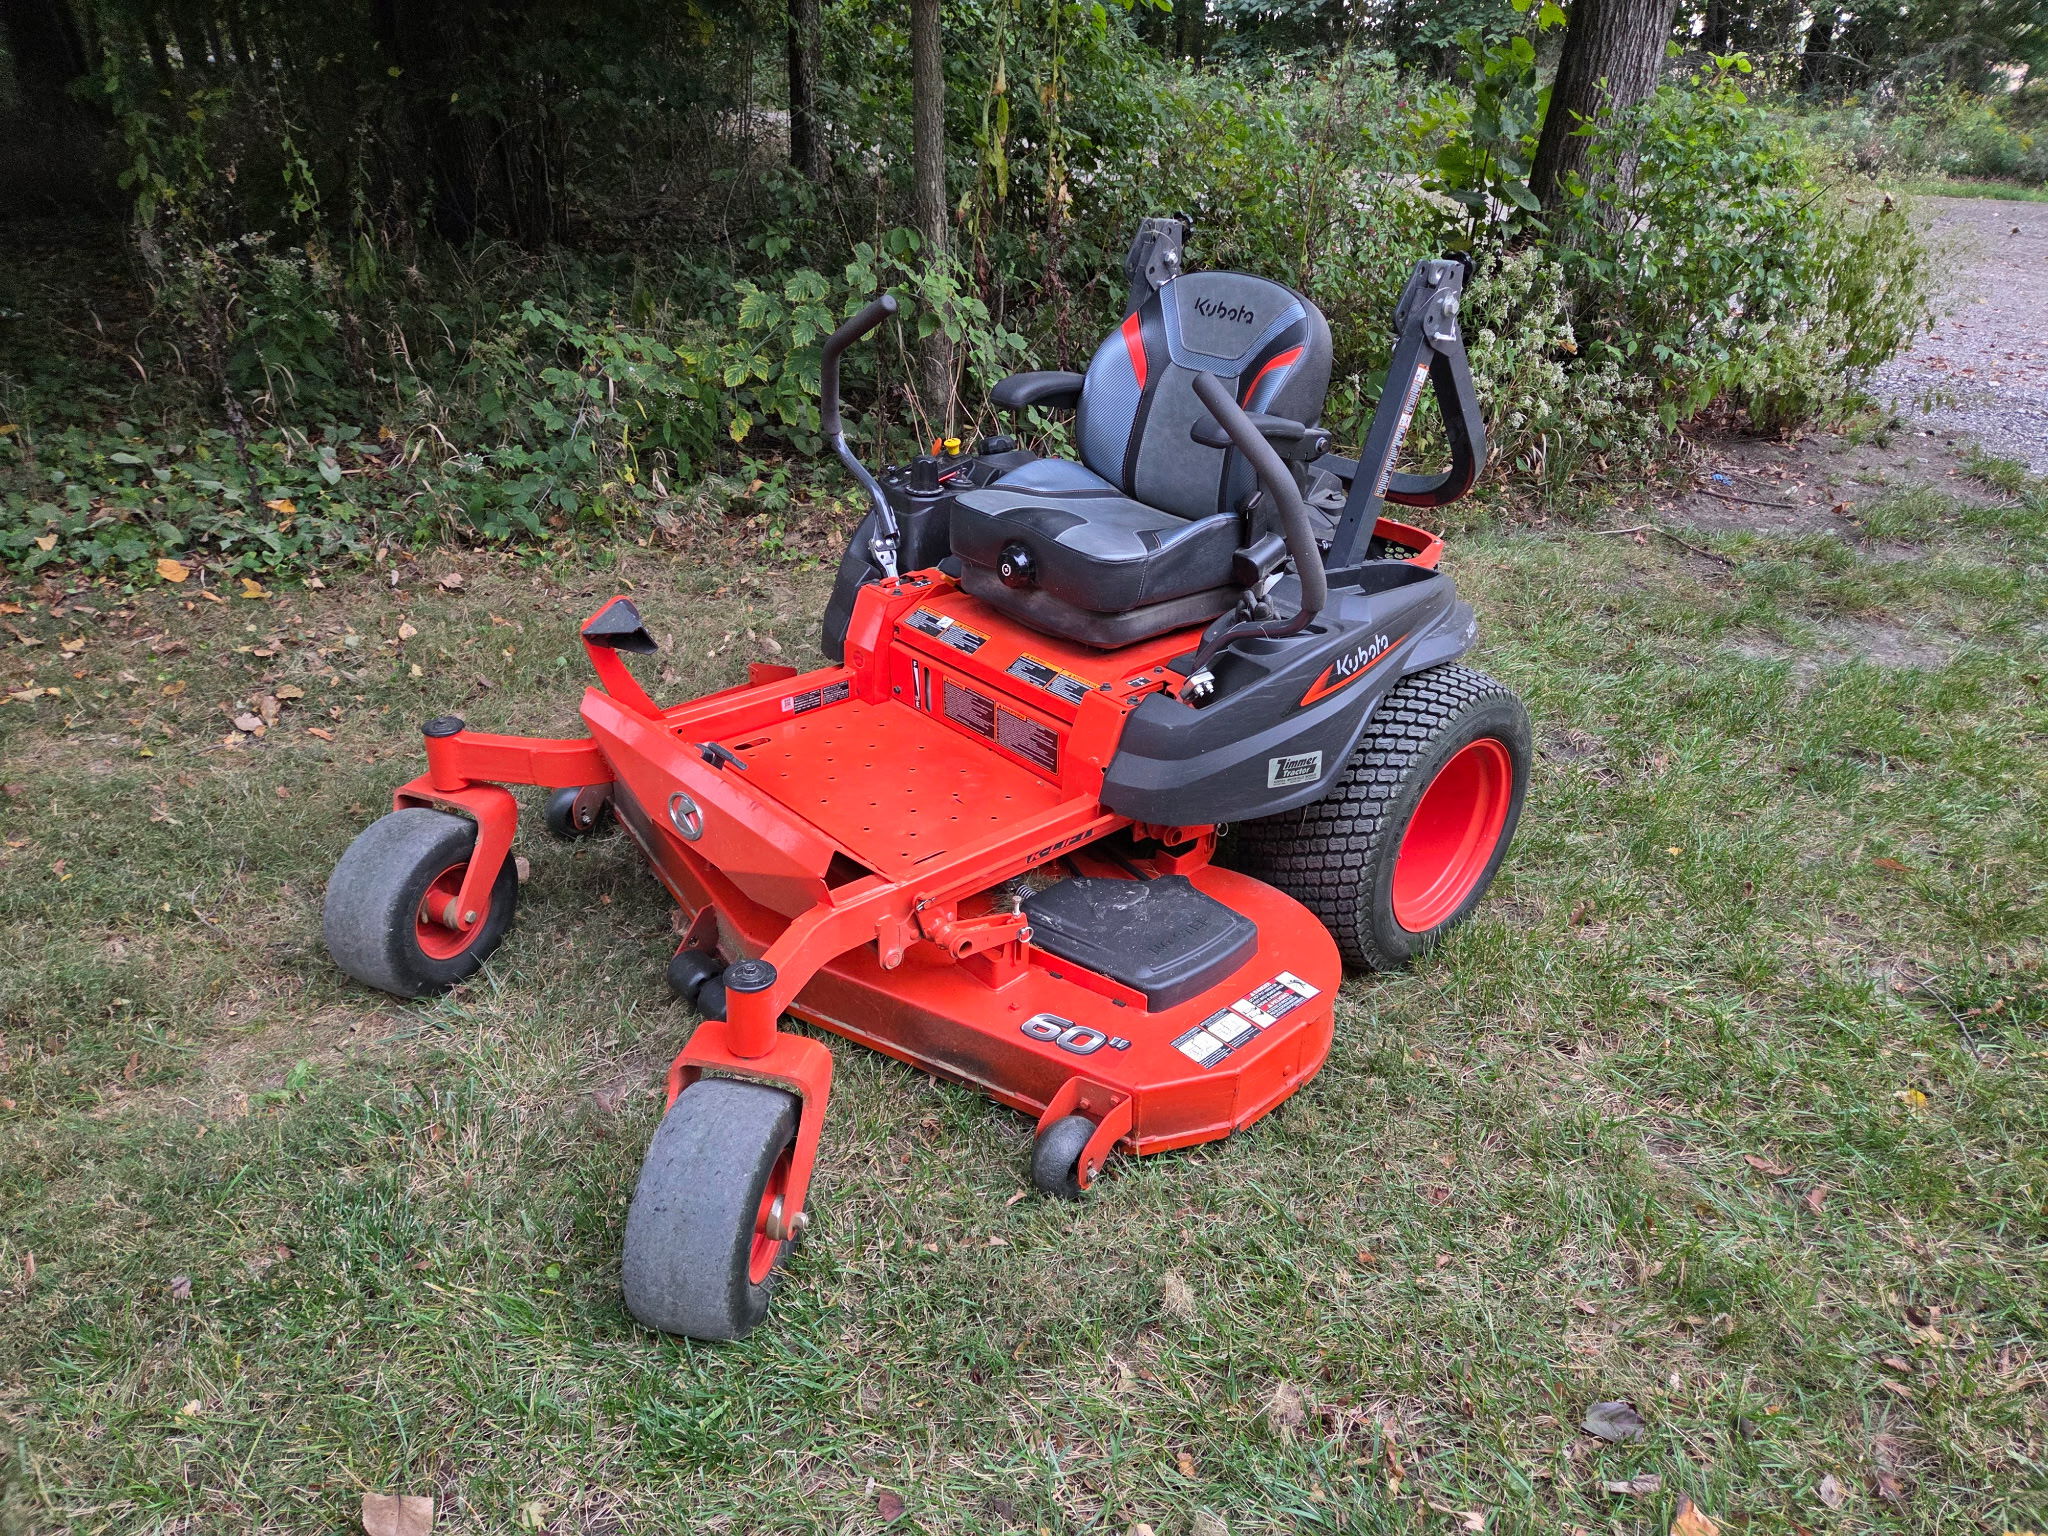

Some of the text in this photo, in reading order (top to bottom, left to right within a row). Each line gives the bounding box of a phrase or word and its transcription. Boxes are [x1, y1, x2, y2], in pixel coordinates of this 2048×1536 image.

[1194, 297, 1254, 325] Kubota
[1336, 634, 1389, 676] Kubota
[1274, 756, 1318, 779] Zimmer
[1282, 767, 1311, 777] Tractor
[1020, 1012, 1132, 1055] 60"
